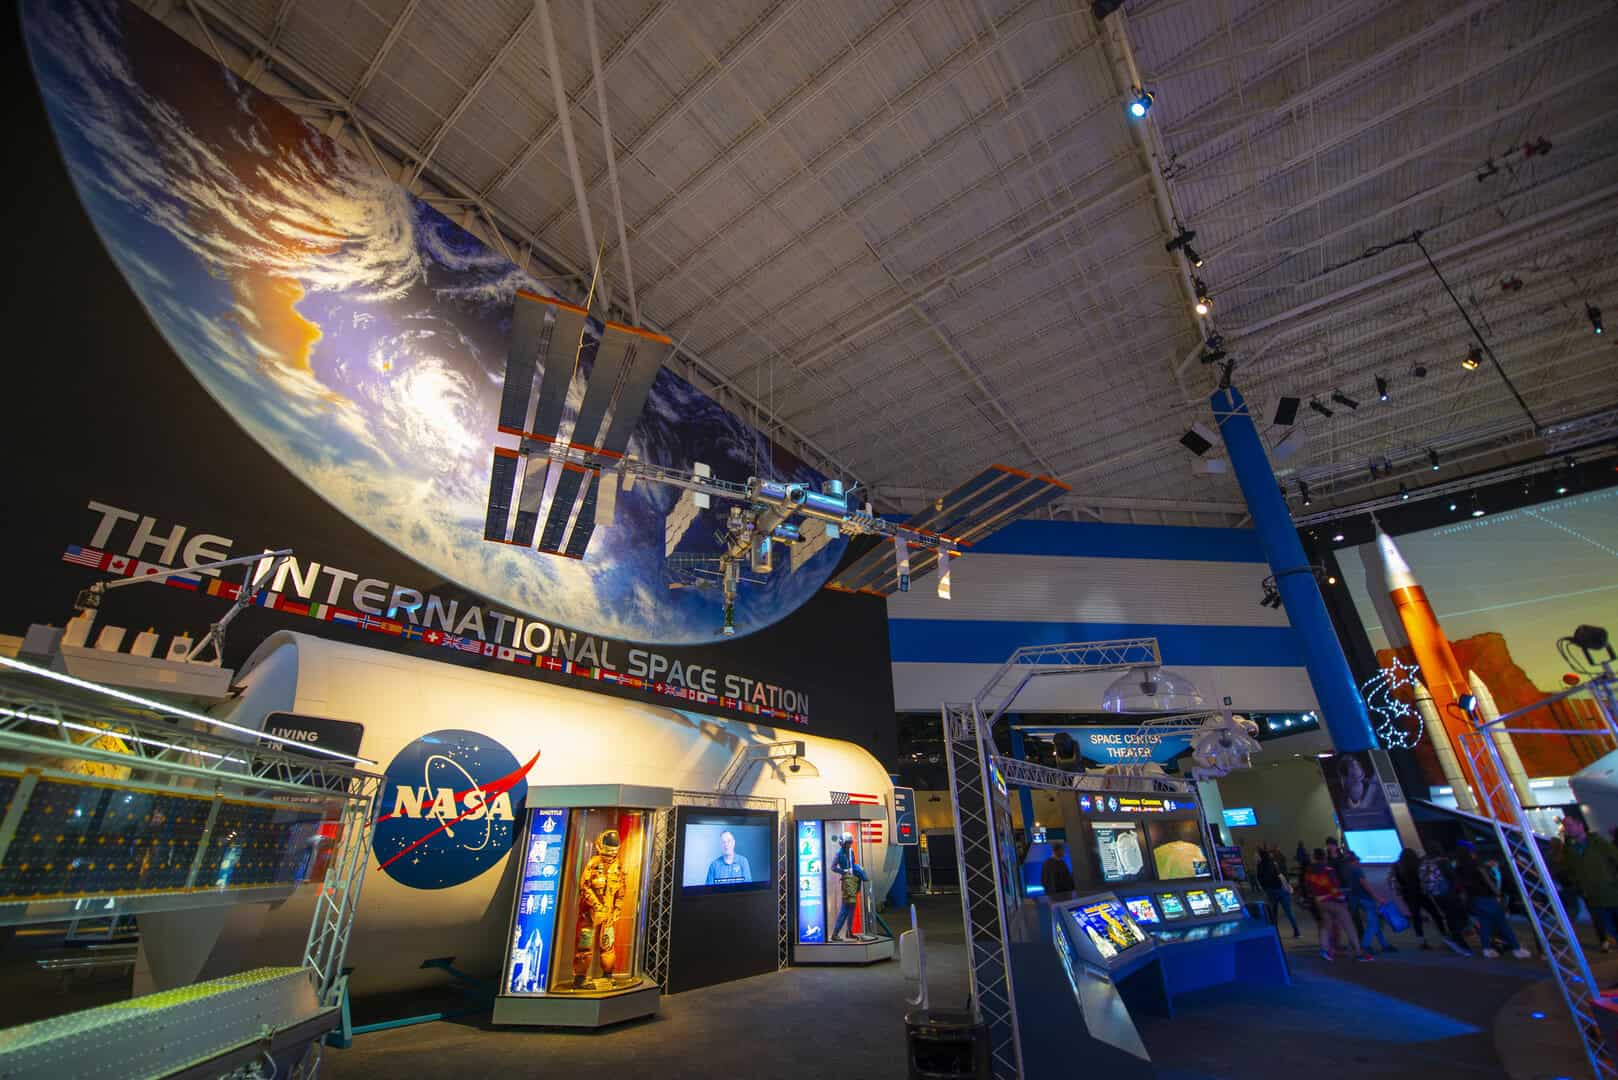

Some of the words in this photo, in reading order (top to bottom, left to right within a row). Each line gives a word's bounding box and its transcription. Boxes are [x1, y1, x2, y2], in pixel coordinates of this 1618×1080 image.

[88, 500, 233, 577] THE
[252, 549, 616, 670] INTERNATIONAL
[628, 649, 716, 694] SPACE
[724, 674, 808, 714] STATION
[271, 727, 319, 742] LIVING
[1090, 734, 1122, 745] SPACE
[1124, 734, 1162, 745] CENTER
[1106, 747, 1152, 758] THEATER
[390, 785, 515, 821] NASA
